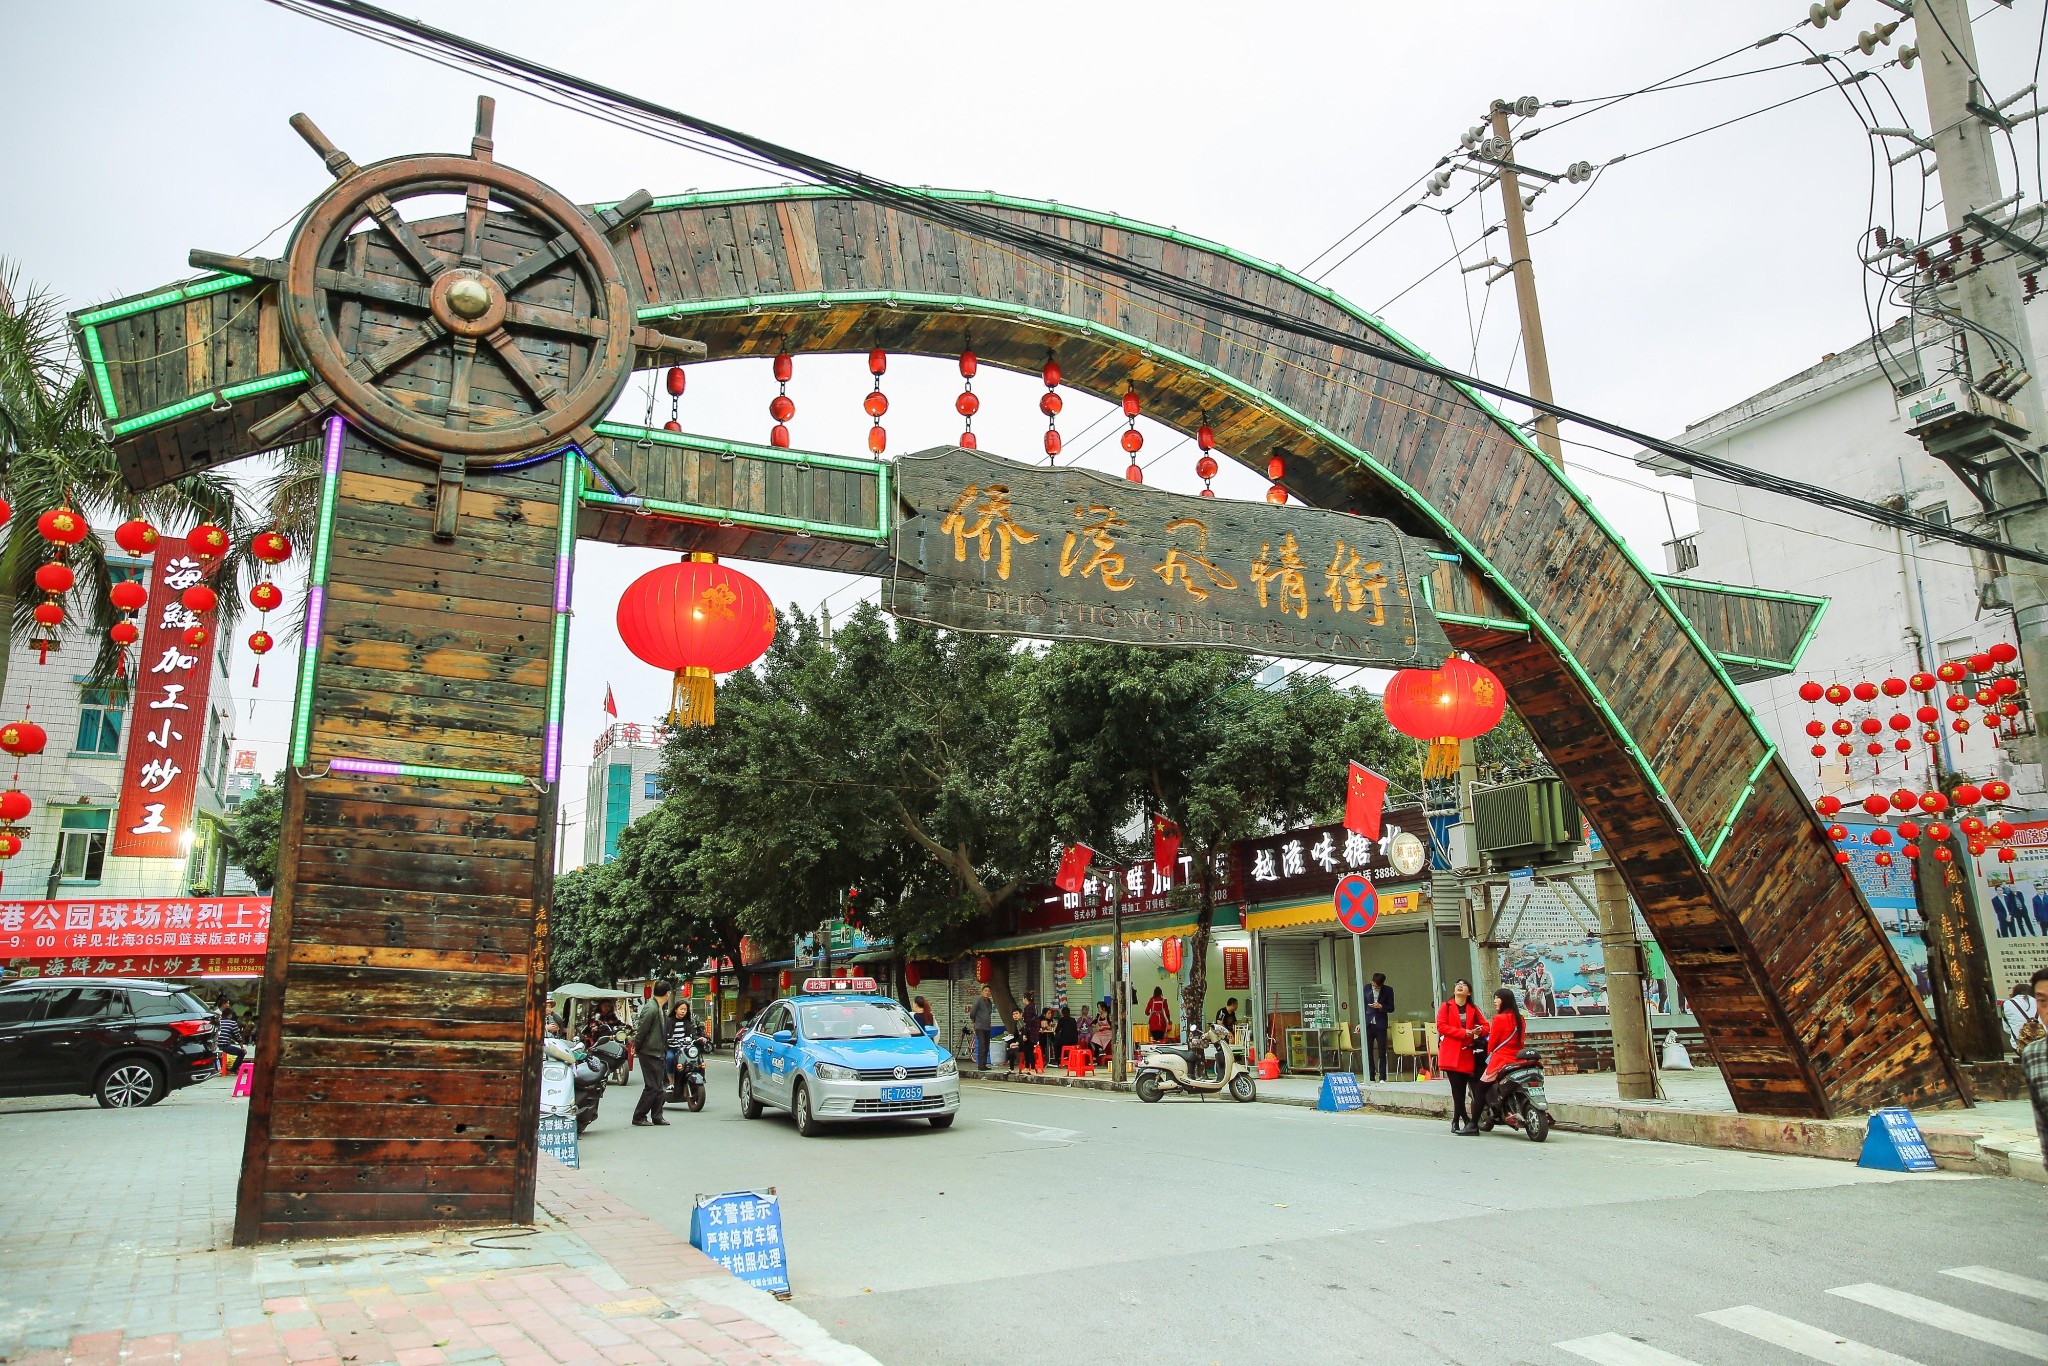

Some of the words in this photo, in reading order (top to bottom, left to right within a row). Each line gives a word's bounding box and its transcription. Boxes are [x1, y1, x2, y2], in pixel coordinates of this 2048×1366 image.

[1101, 902, 1141, 915] 欢迎料加工
[538, 1133, 575, 1146] 禁停放车辆
[708, 1200, 771, 1226] 交警提示
[706, 1224, 779, 1252] 严禁停放车辆
